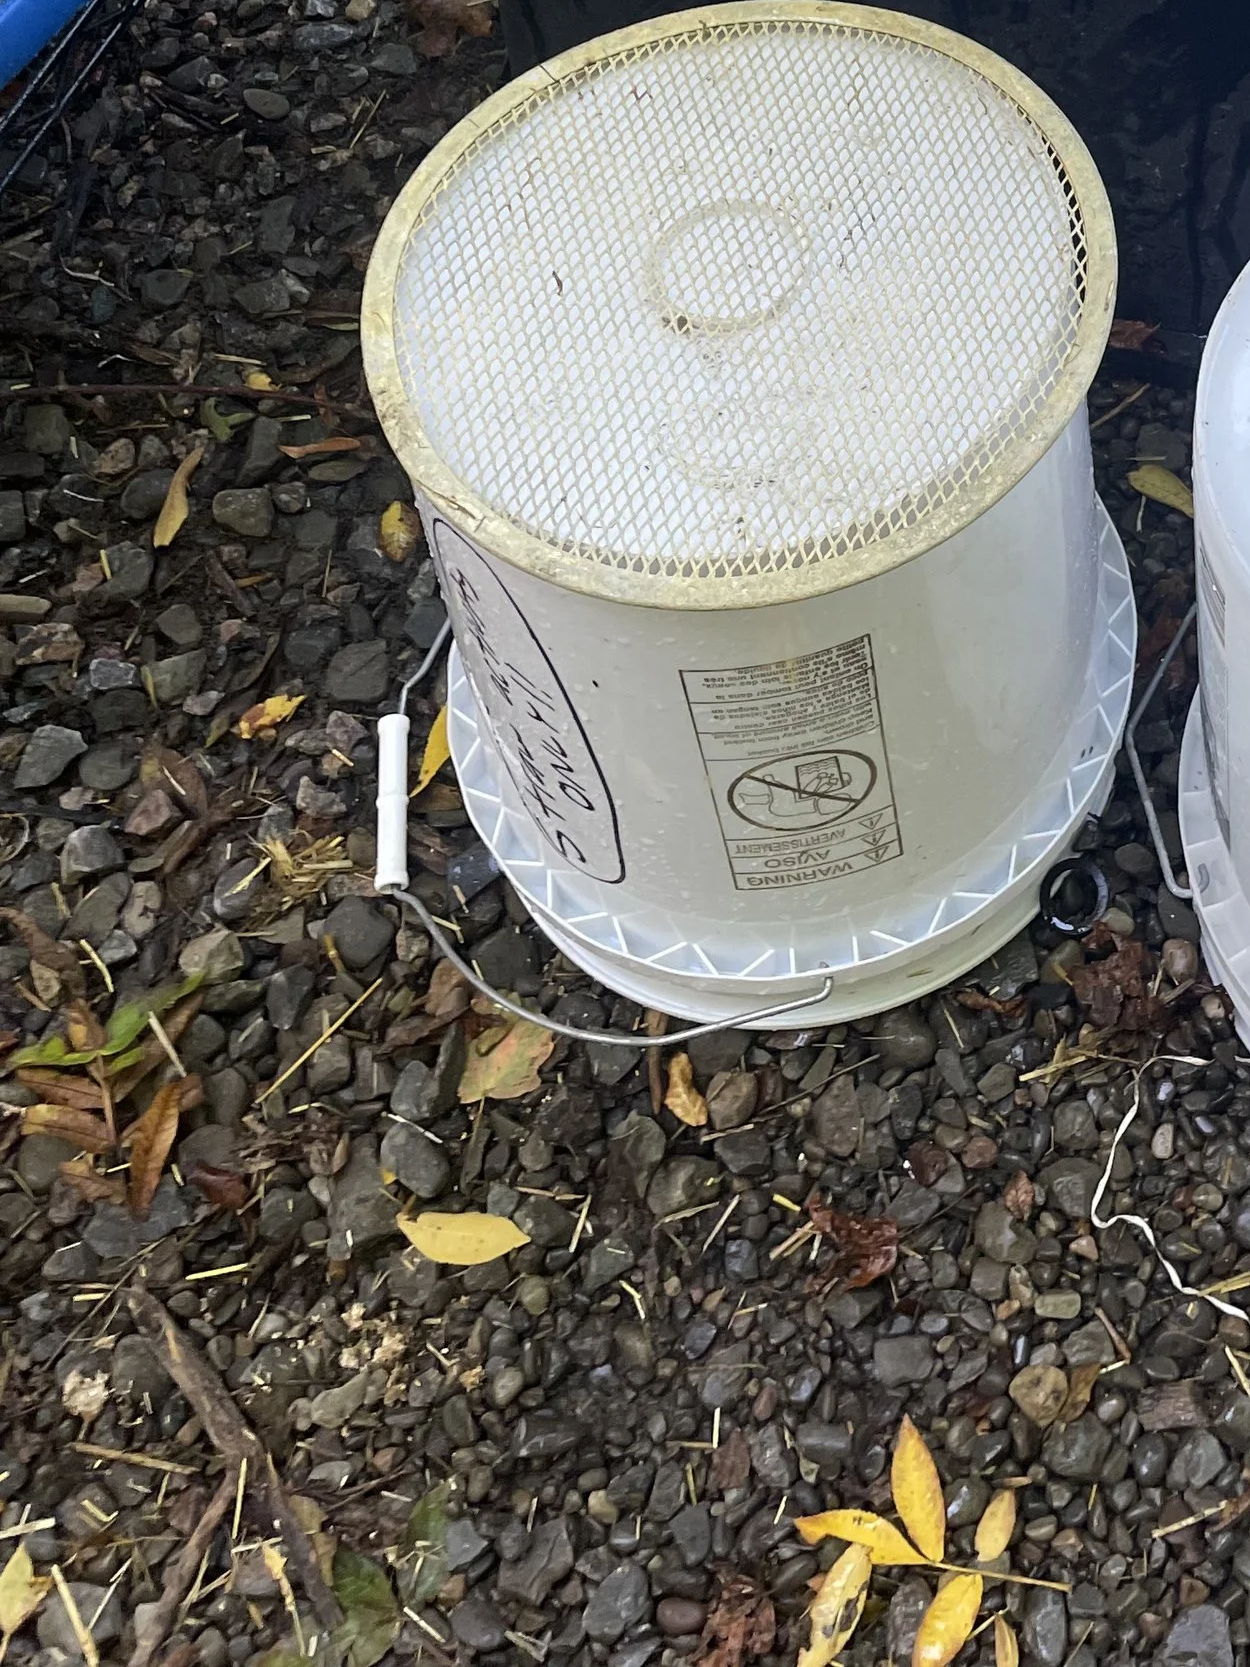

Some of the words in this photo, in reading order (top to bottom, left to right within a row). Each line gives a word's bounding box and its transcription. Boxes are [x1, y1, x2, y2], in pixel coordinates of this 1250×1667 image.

[736, 829, 845, 854] AVERTISSEMENT
[764, 850, 830, 868] AVISO
[747, 862, 853, 886] WARNING
